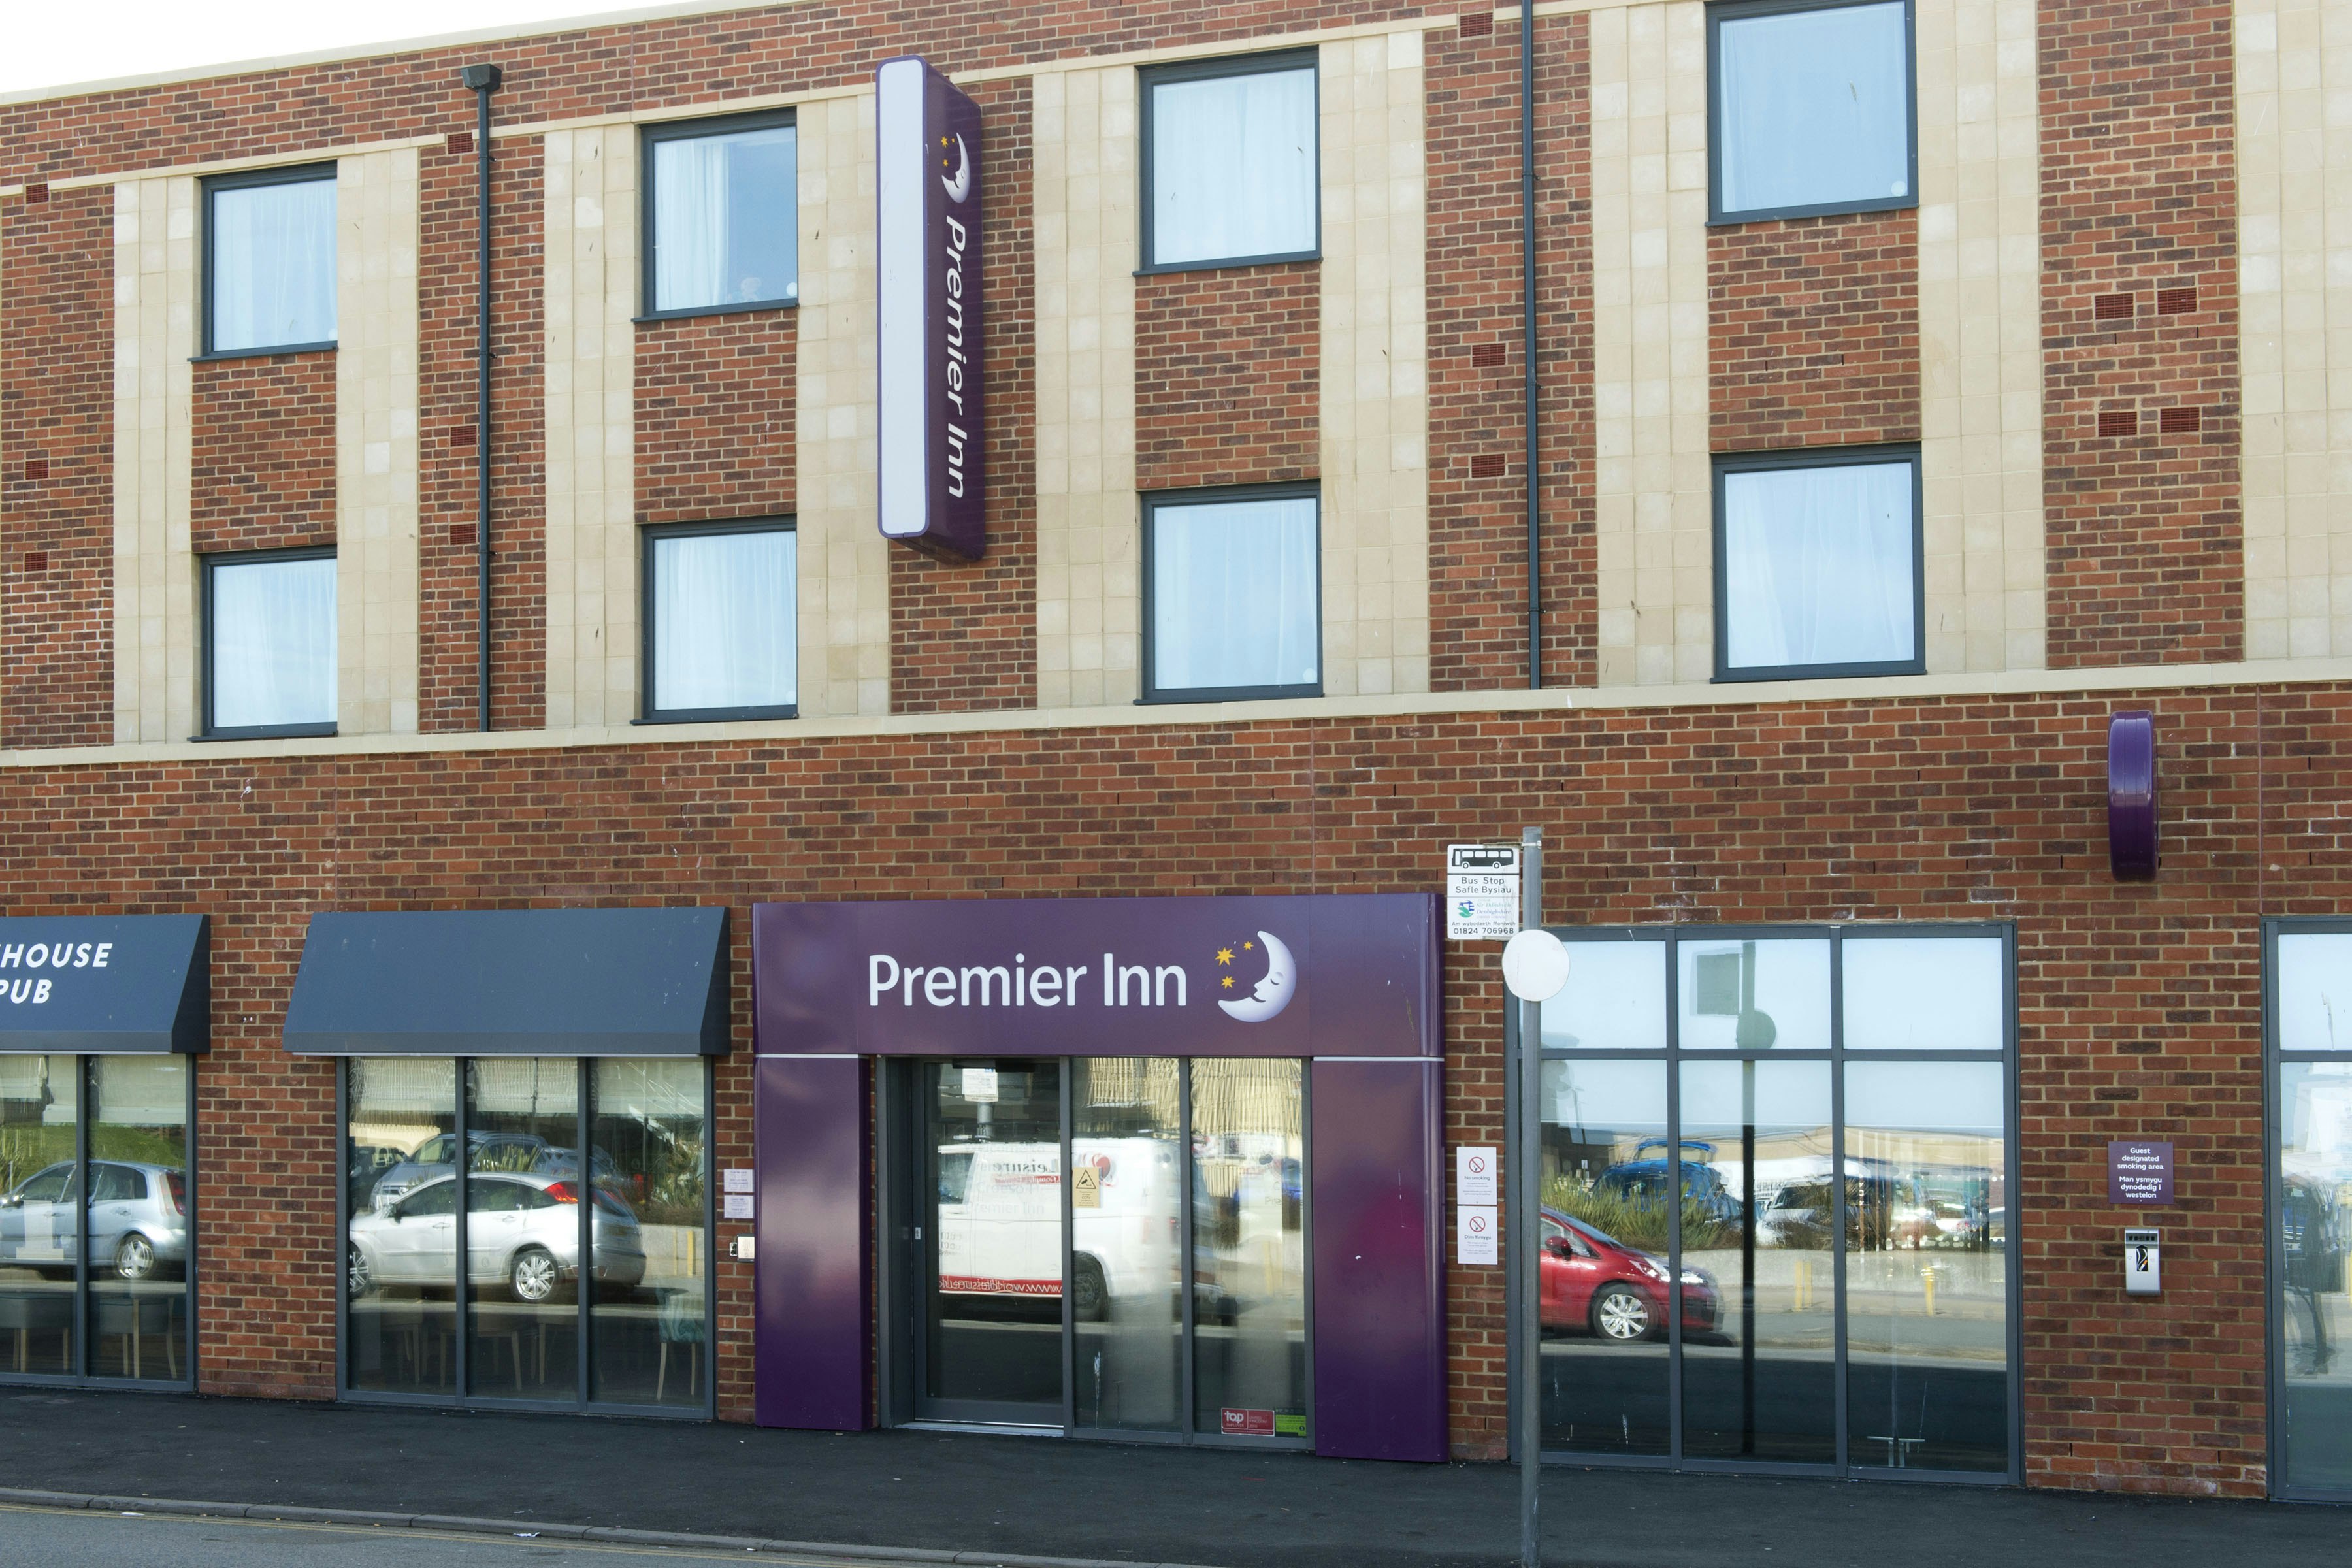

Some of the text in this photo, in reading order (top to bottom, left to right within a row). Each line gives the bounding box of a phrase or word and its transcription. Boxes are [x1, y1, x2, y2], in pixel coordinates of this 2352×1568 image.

[946, 214, 968, 498] Premier Inn
[1482, 886, 1511, 894] Bysiau
[1483, 877, 1505, 885] Stop
[0, 943, 113, 968] HOUSE
[869, 953, 1187, 1007] Premier Inn
[1224, 1411, 1244, 1423] top
